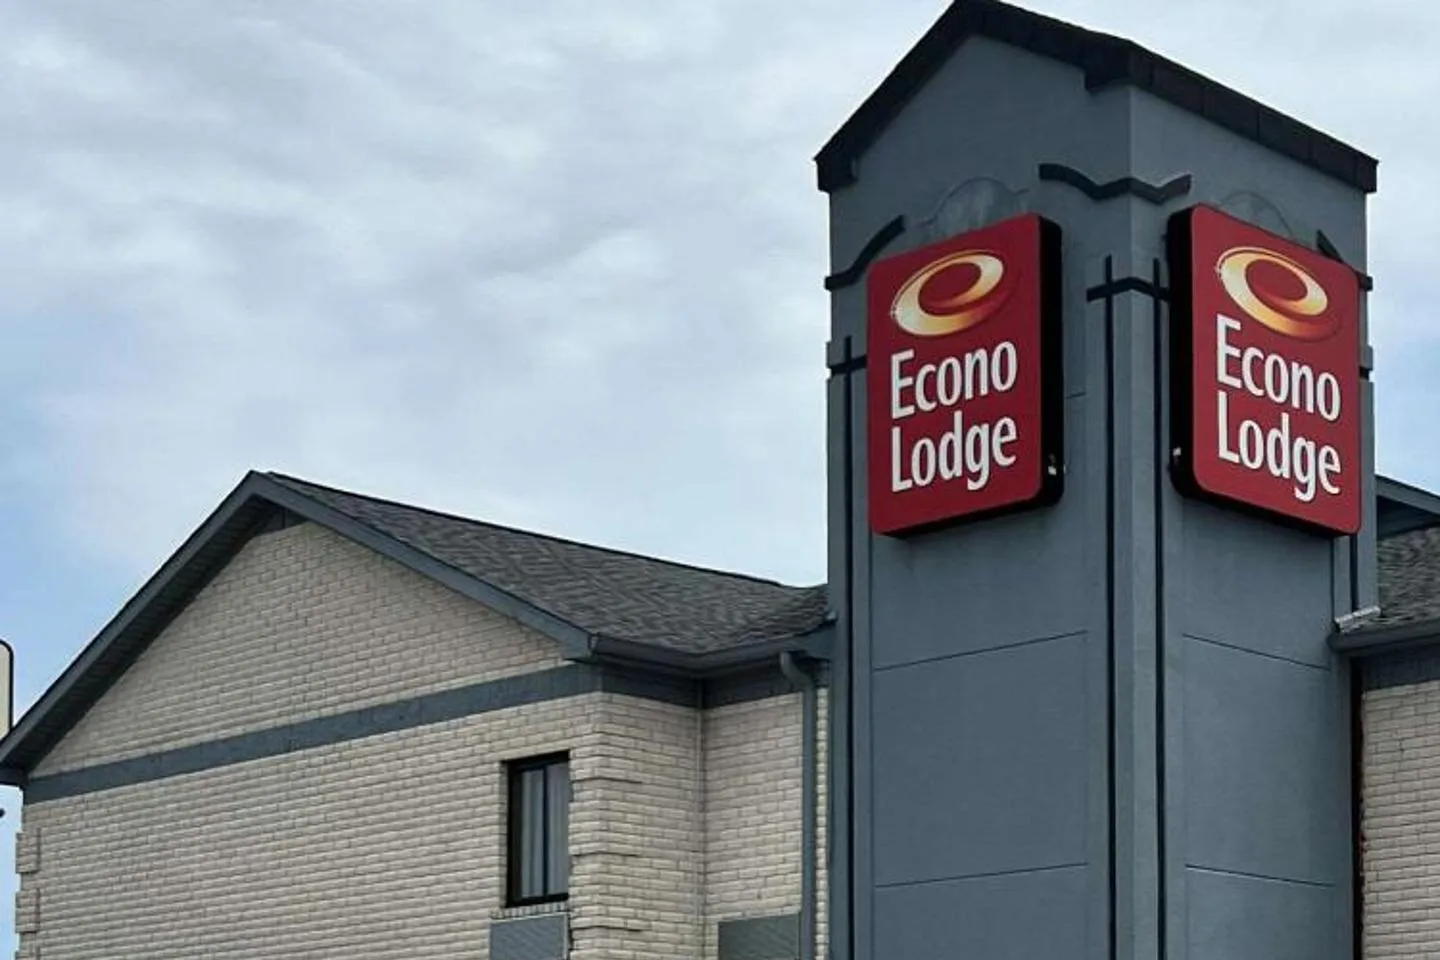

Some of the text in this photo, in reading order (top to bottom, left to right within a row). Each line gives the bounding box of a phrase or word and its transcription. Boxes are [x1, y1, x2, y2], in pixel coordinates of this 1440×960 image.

[891, 341, 1017, 420] Econo
[1217, 313, 1341, 421] Econo
[891, 410, 1017, 492] Lodge
[1217, 389, 1341, 502] Lodge
